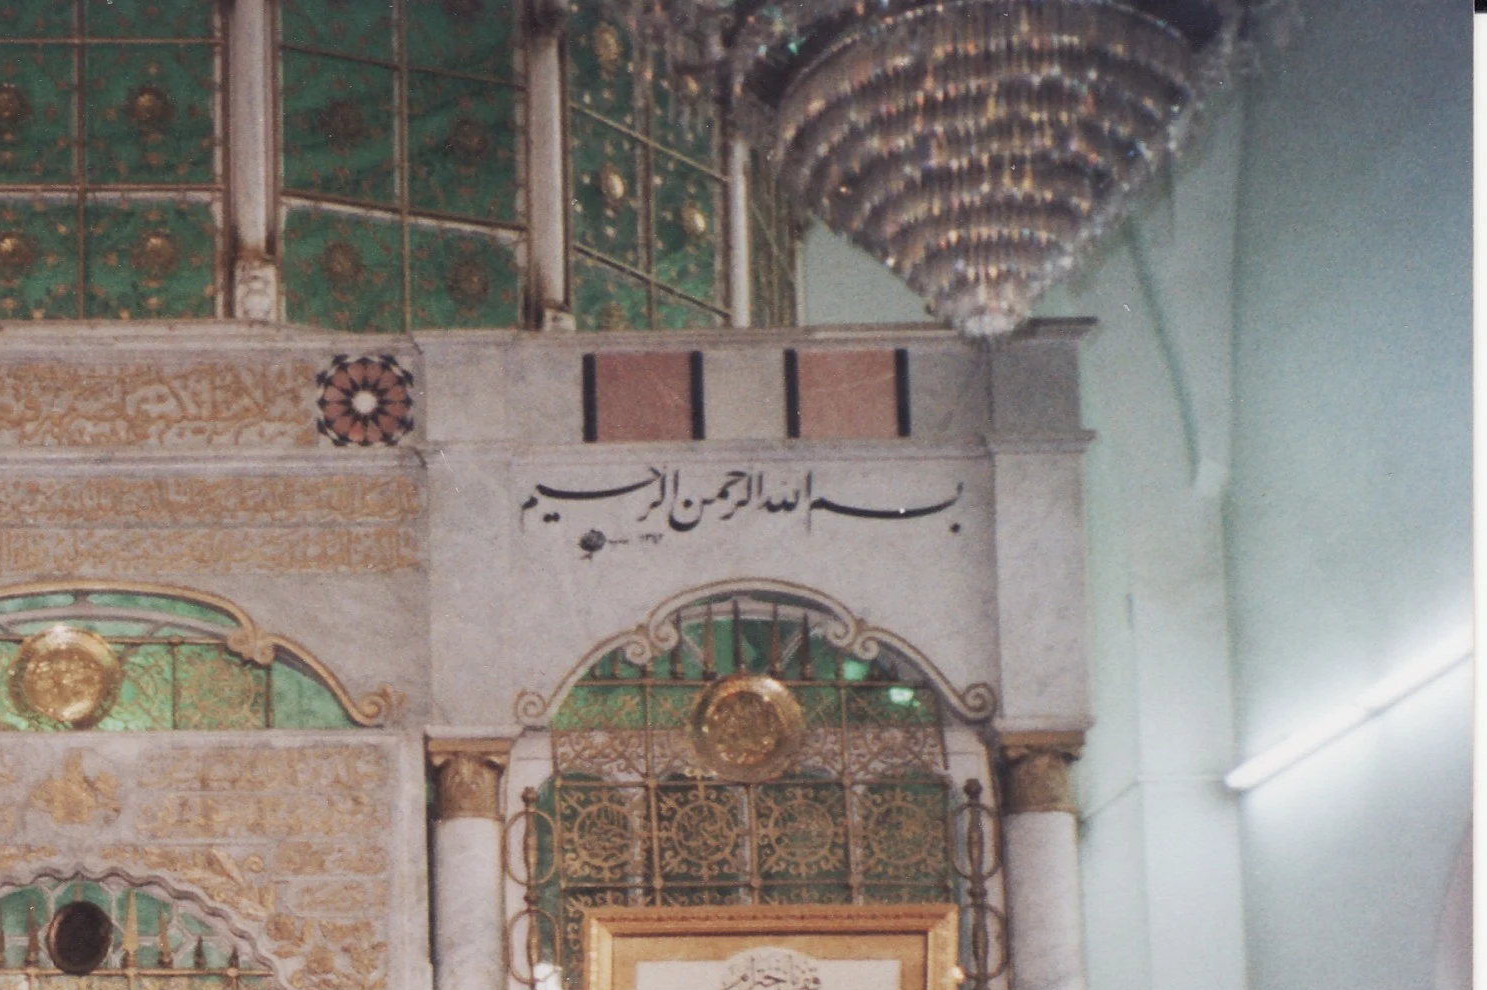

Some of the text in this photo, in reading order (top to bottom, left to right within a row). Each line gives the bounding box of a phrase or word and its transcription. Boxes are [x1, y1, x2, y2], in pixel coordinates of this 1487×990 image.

[518, 466, 964, 536] بسم الله الرحمن الرحيم
